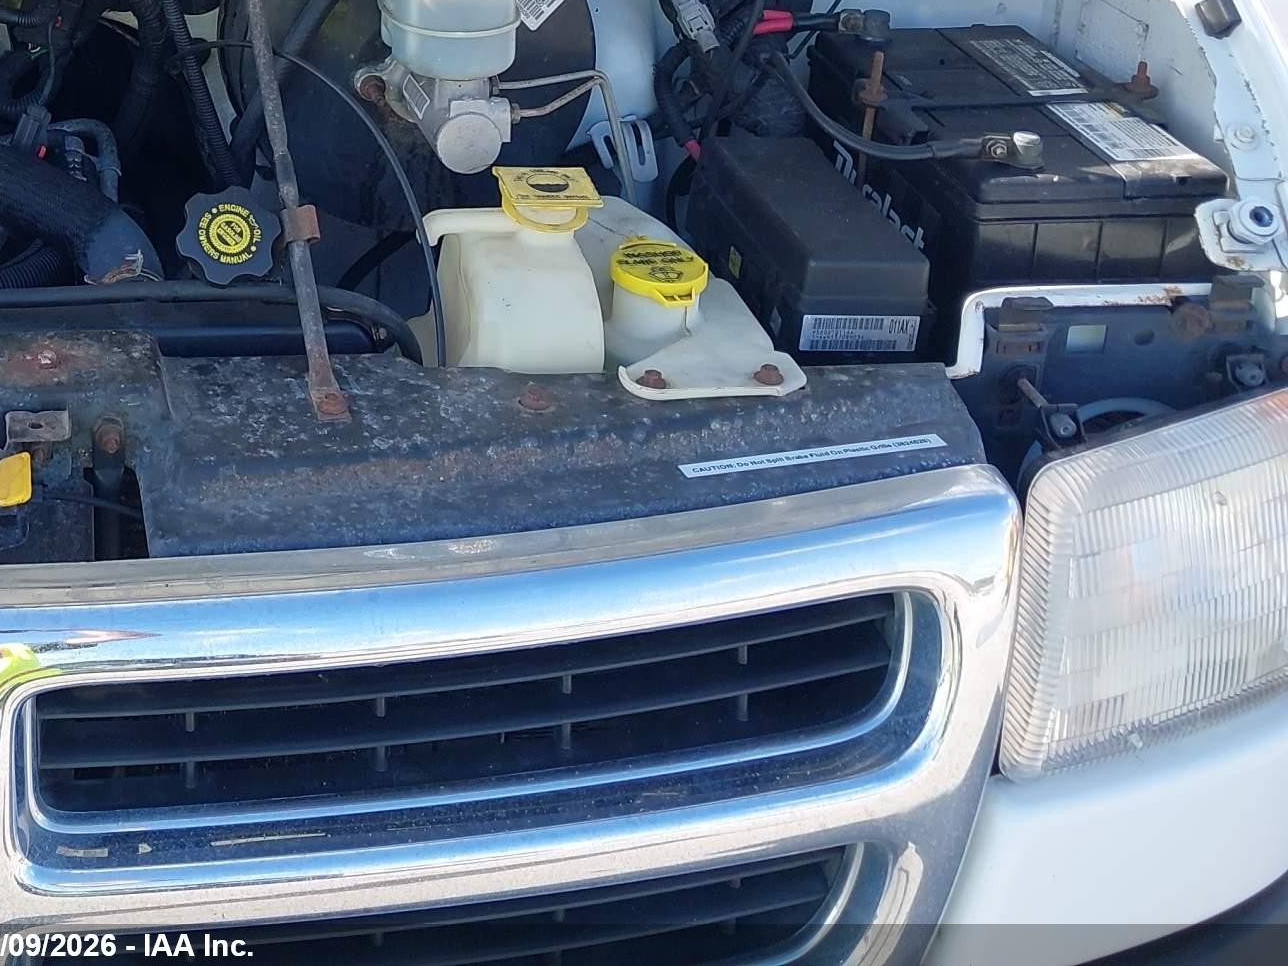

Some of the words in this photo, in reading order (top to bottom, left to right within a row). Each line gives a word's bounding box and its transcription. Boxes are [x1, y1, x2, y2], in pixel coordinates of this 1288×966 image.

[199, 212, 212, 229] SEE
[219, 203, 250, 218] ENGINE
[253, 229, 261, 243] OIL
[198, 229, 220, 260] OWNERS
[219, 252, 253, 264] MANUAL
[766, 456, 785, 465] Spill
[785, 454, 809, 462] Brake
[844, 446, 870, 454] Plastic
